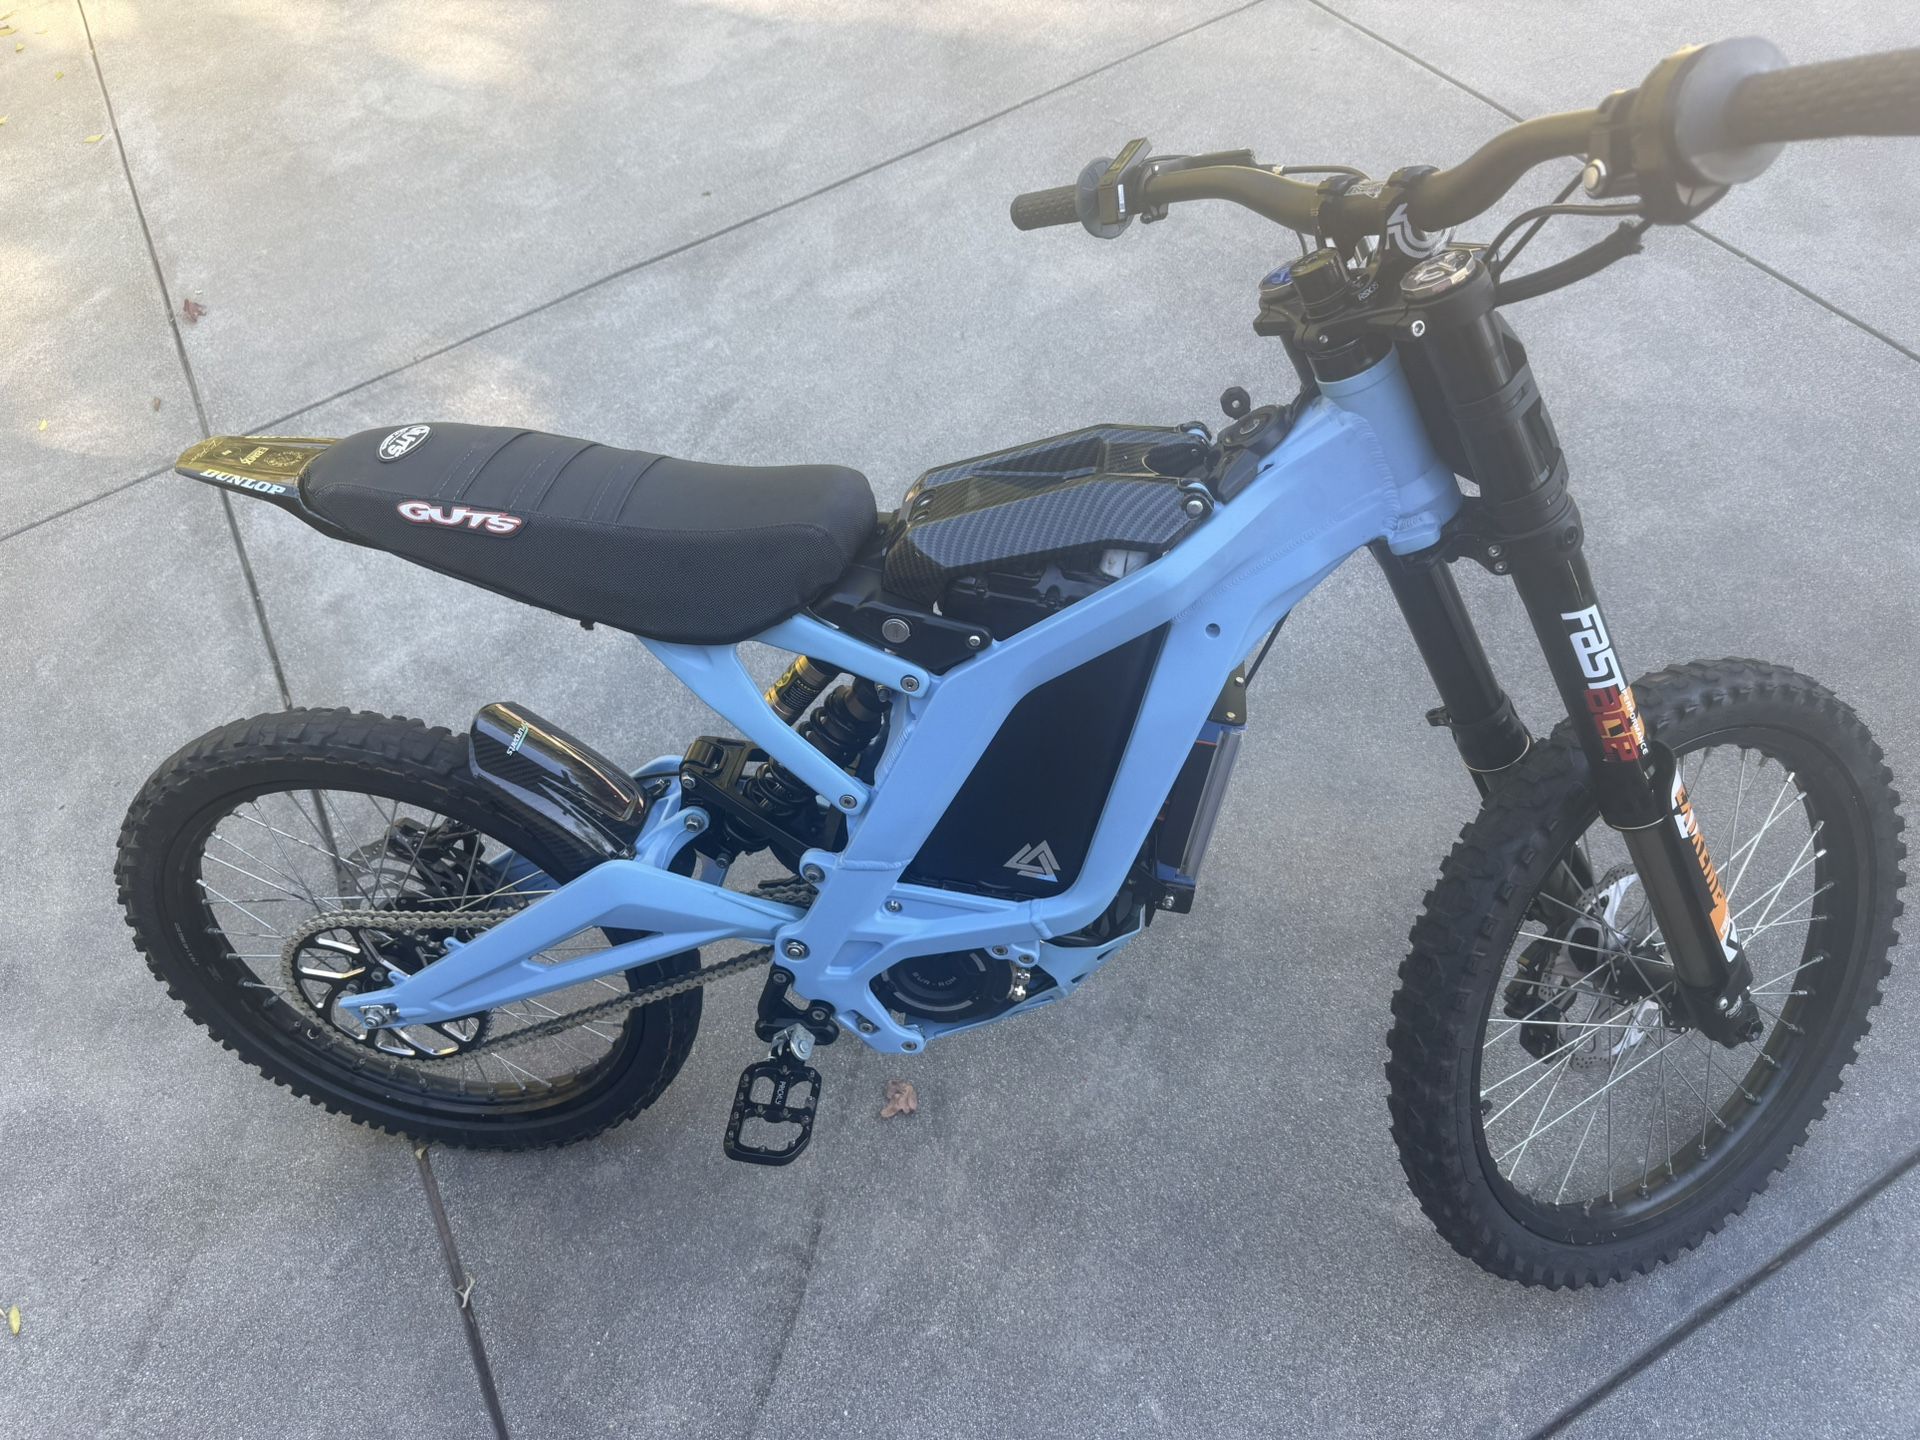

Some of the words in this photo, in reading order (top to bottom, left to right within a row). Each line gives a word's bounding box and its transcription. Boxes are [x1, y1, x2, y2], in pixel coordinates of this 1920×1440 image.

[200, 469, 286, 494] DUNLOP
[398, 500, 521, 534] GUTS
[1622, 688, 1649, 755] PERFORMANCE
